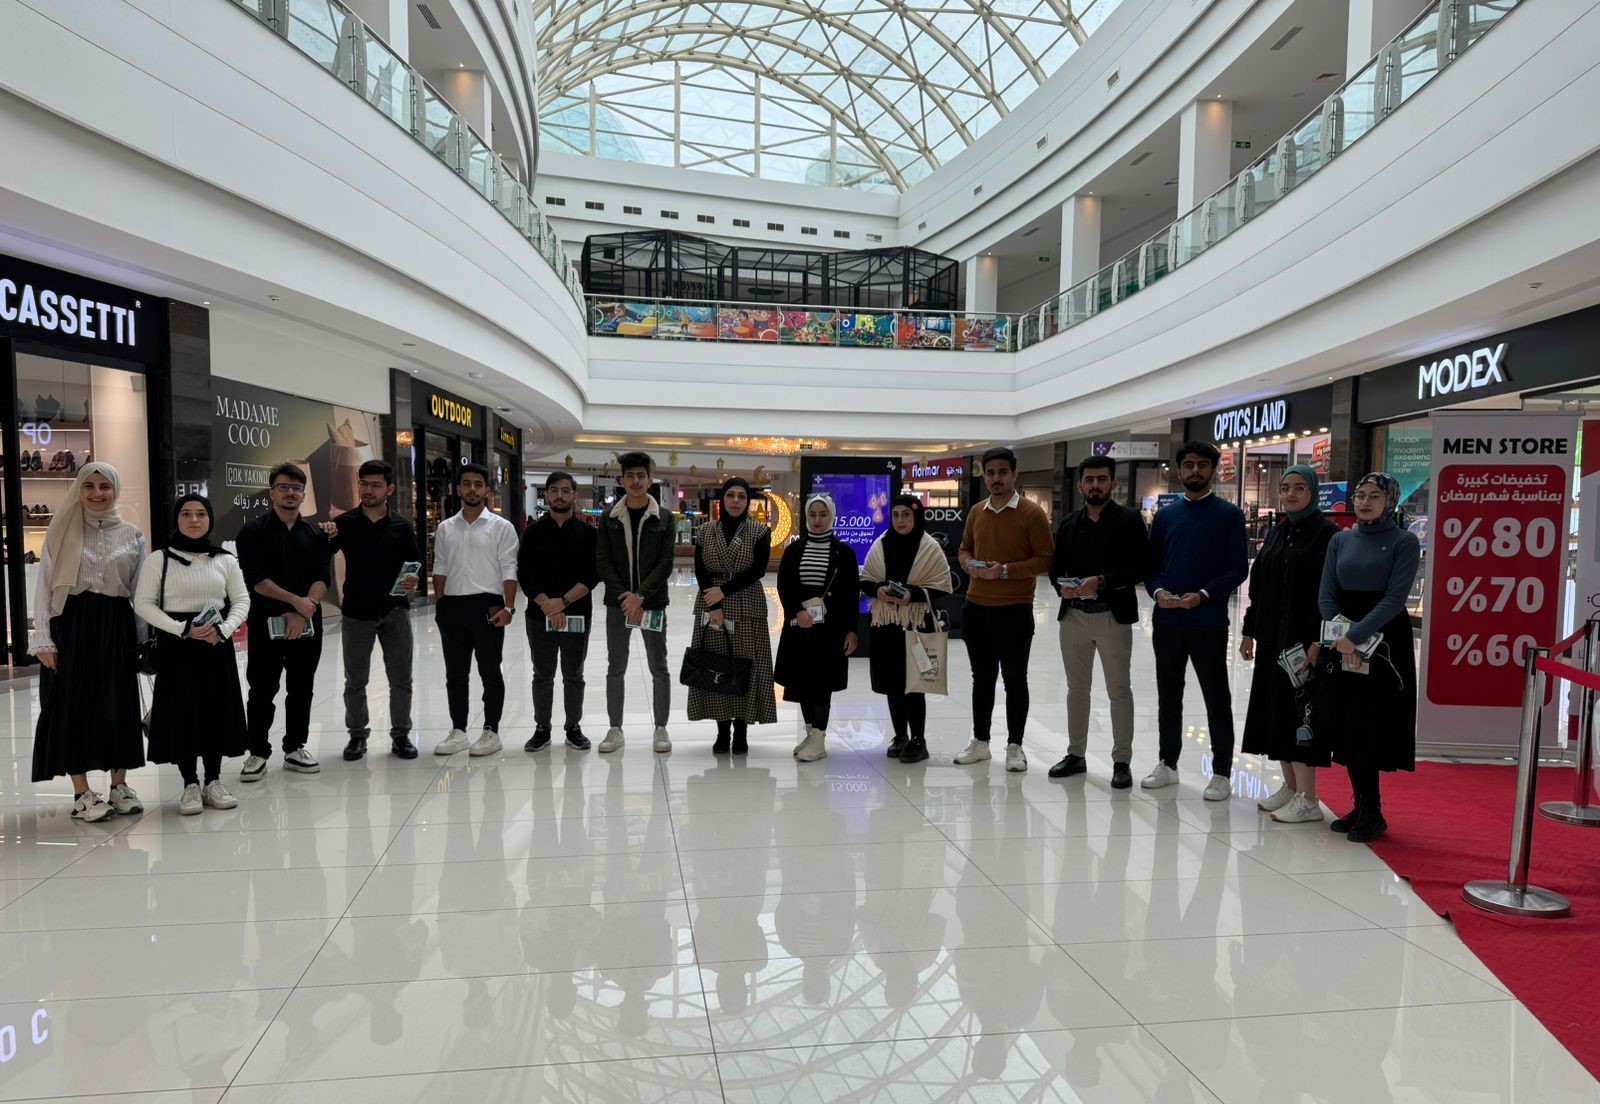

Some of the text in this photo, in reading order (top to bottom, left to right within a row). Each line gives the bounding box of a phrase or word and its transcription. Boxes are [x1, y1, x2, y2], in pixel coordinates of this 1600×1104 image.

[0, 278, 136, 346] CASSETTI
[1418, 343, 1505, 400] MODEX
[216, 395, 280, 427] MADAME
[431, 394, 472, 428] OUTDOOR
[1214, 400, 1287, 441] OPTICS LAND
[228, 423, 270, 449] COCO
[1443, 438, 1567, 454] MEN STORE
[1440, 489, 1562, 504] بمناسبة شهر رمضان
[1457, 473, 1547, 488] تخفيضات كبيرة
[833, 516, 871, 528] 15.000
[924, 509, 962, 521] ODEX
[1442, 517, 1556, 558] %80
[1446, 576, 1545, 614] %70
[1446, 633, 1538, 667] %60
